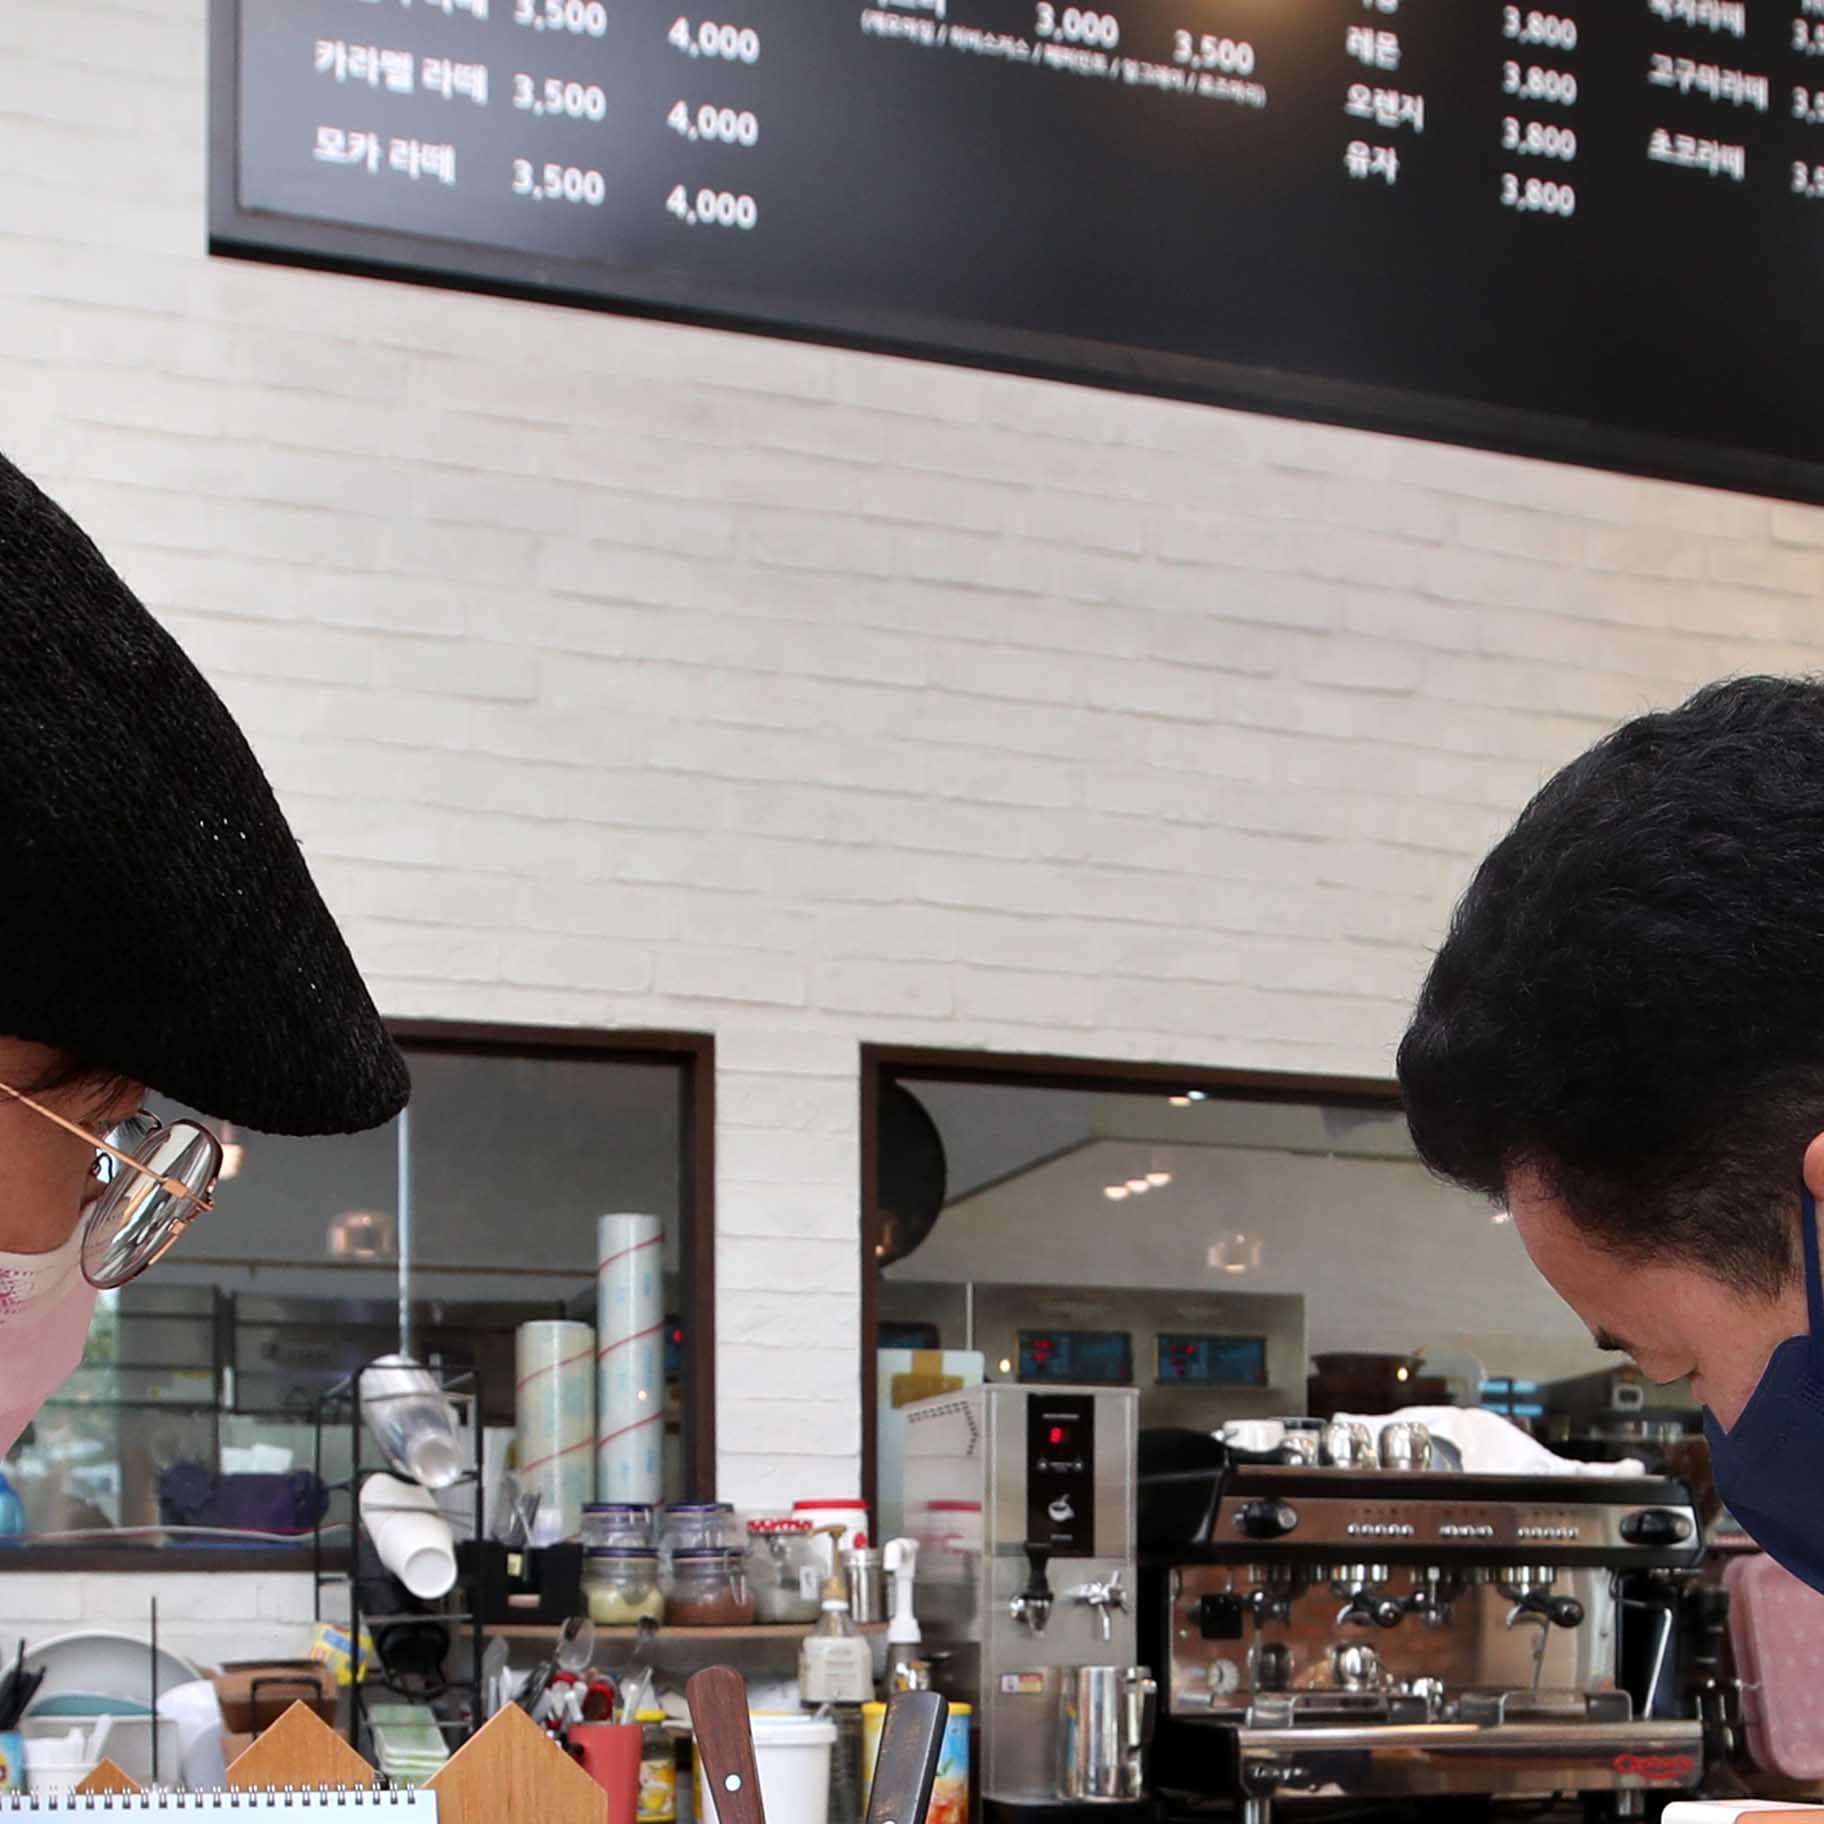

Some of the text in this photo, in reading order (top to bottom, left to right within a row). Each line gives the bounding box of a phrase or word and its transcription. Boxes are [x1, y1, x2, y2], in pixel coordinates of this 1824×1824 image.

[668, 17, 760, 64] 4,000
[1036, 1, 1255, 76] 3,000 3,500
[1346, 25, 1577, 106] 레몬 3,800
[1502, 4, 1577, 51] 3,800
[315, 39, 415, 95] 카라멜
[512, 73, 607, 121] 3,500
[667, 100, 759, 148] 4,000
[1344, 83, 1576, 161] 오렌지 3,800
[314, 126, 378, 173] 모카
[512, 158, 605, 206] 3,500
[666, 184, 757, 230] 4,000
[1344, 140, 1575, 217] 유자 3,800
